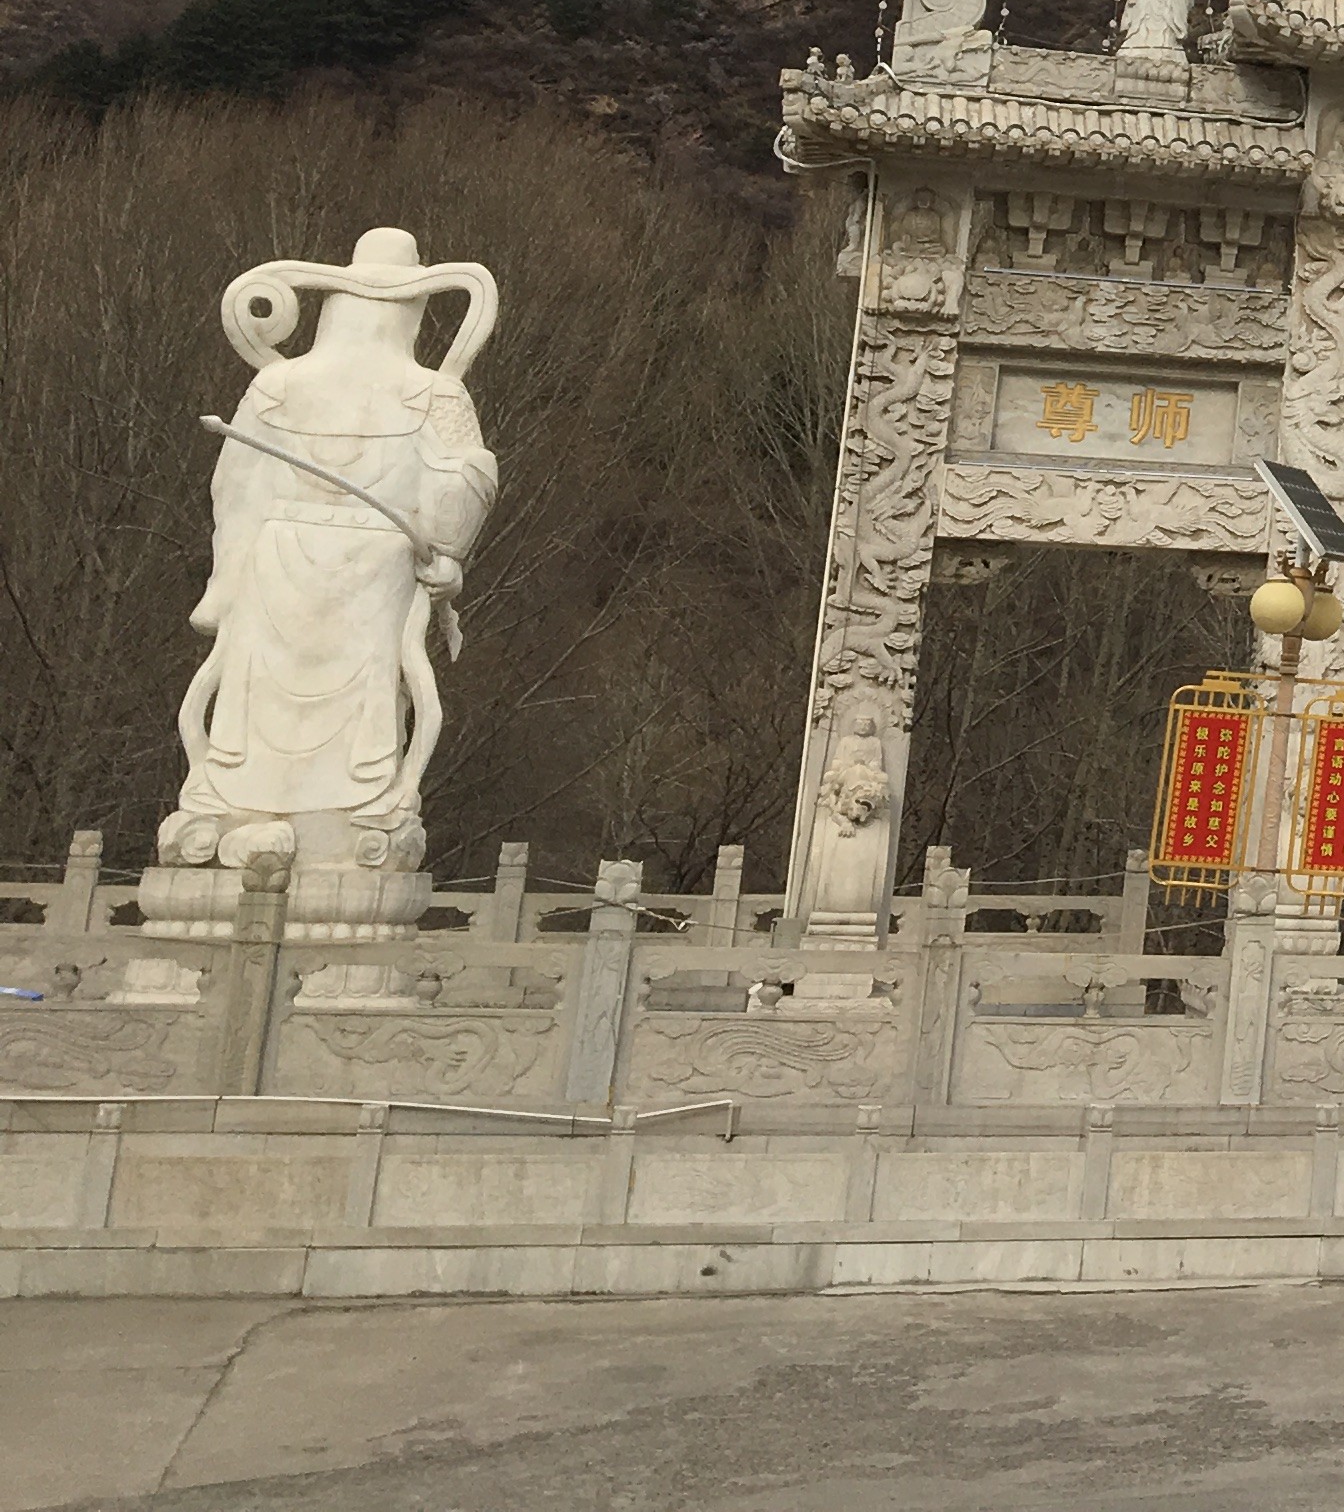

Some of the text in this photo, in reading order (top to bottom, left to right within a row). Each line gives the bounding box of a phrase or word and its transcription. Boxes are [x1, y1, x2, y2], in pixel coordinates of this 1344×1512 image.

[1035, 381, 1195, 449] 尊师
[1182, 726, 1209, 847] 极乐原来是故乡
[1205, 728, 1234, 848] 弥陀护念如慈父
